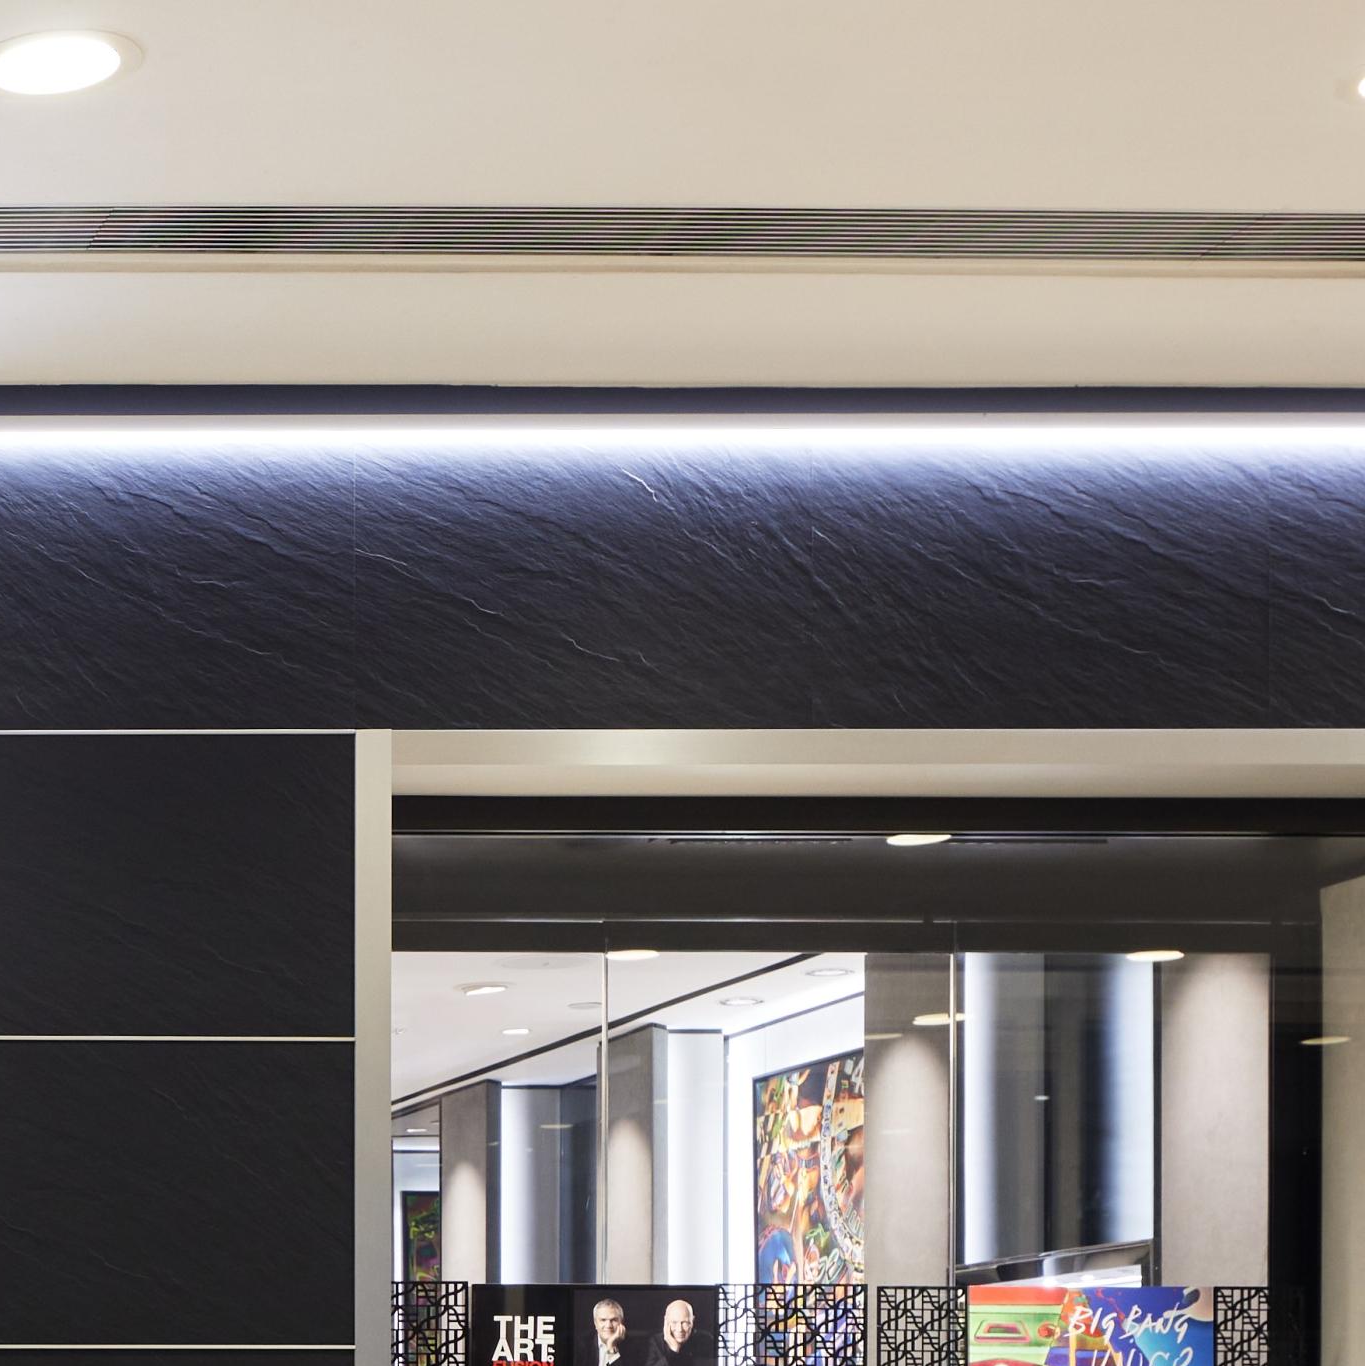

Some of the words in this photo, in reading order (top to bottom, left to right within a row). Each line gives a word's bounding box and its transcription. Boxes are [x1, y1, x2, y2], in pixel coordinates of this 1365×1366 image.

[493, 1315, 556, 1339] THE
[1063, 1305, 1118, 1345] BIG
[1119, 1303, 1190, 1345] BANG
[491, 1338, 556, 1362] ART
